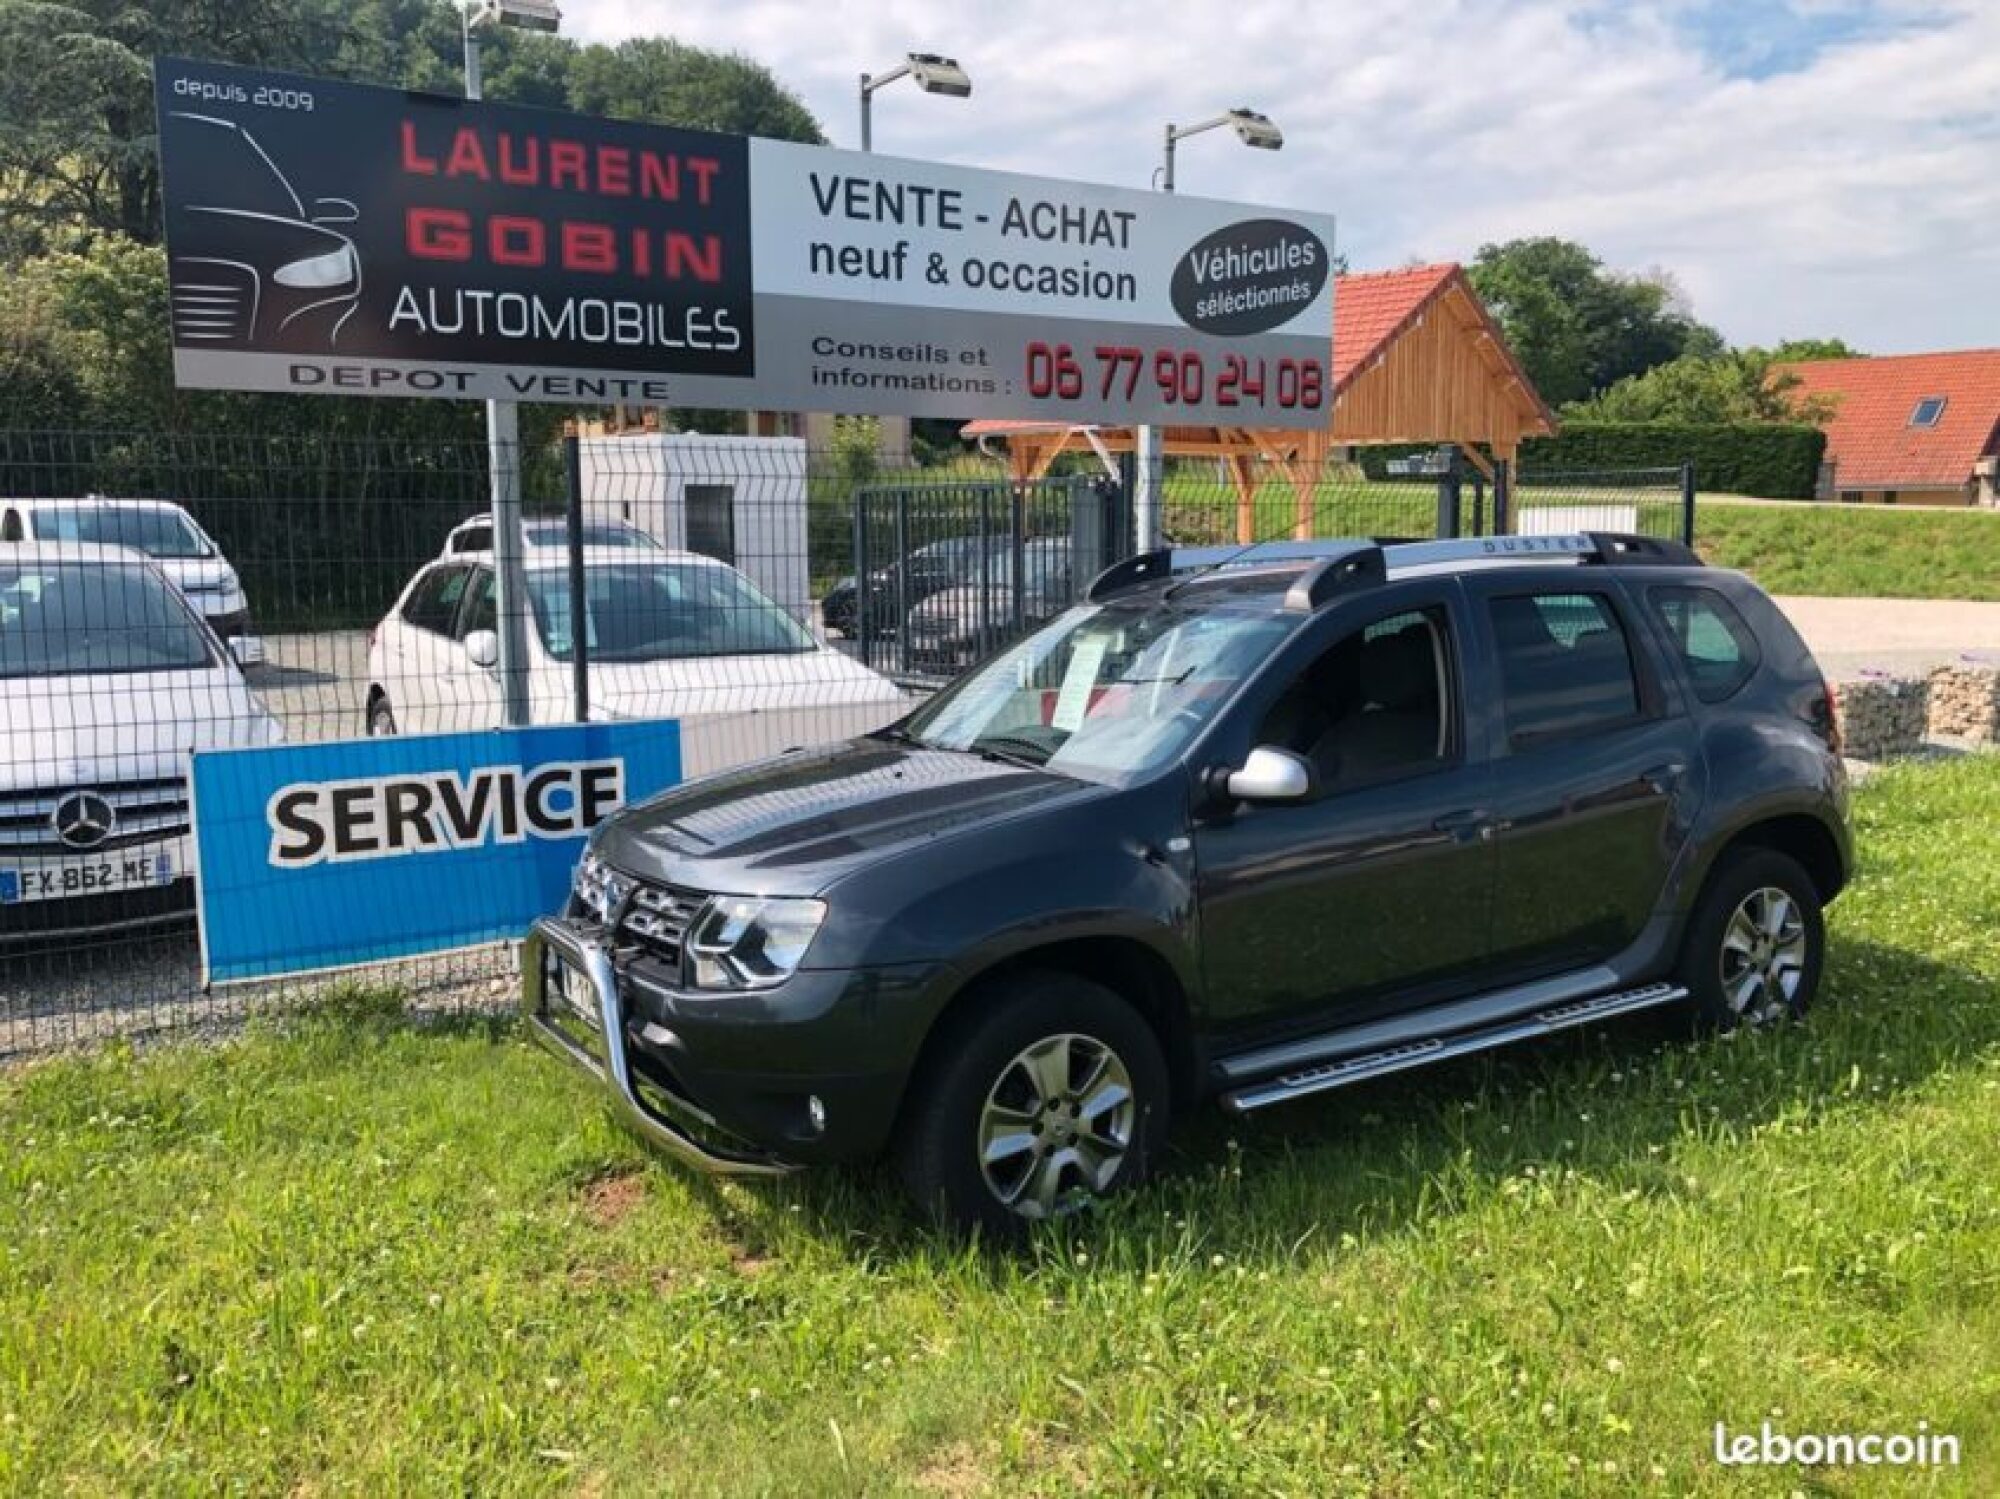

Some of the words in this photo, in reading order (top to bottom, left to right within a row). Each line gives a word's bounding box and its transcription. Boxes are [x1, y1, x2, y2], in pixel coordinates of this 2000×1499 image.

[174, 77, 248, 101] depuis
[254, 87, 315, 112] 2009
[402, 122, 721, 205] LAURENT
[809, 172, 963, 231] VENTE
[1000, 198, 1137, 249] ACHAT
[406, 209, 723, 281] GOBIN
[810, 241, 910, 280] neuf
[924, 252, 949, 285] &
[962, 258, 1137, 302] occasion
[1189, 238, 1317, 283] Véhicules
[389, 285, 741, 351] AUTOMOBILES
[289, 364, 477, 392] DEPOT
[505, 374, 669, 400] VENTE
[812, 337, 951, 366] Conseils
[958, 346, 989, 366] et
[812, 365, 997, 395] informations
[1026, 342, 1082, 401] 06
[1095, 346, 1143, 402] 77
[1155, 351, 1203, 405] 90
[1217, 355, 1265, 409] 24
[1277, 358, 1324, 410] 08
[1484, 537, 1589, 552] DUSTER
[275, 765, 619, 860] SERVICE
